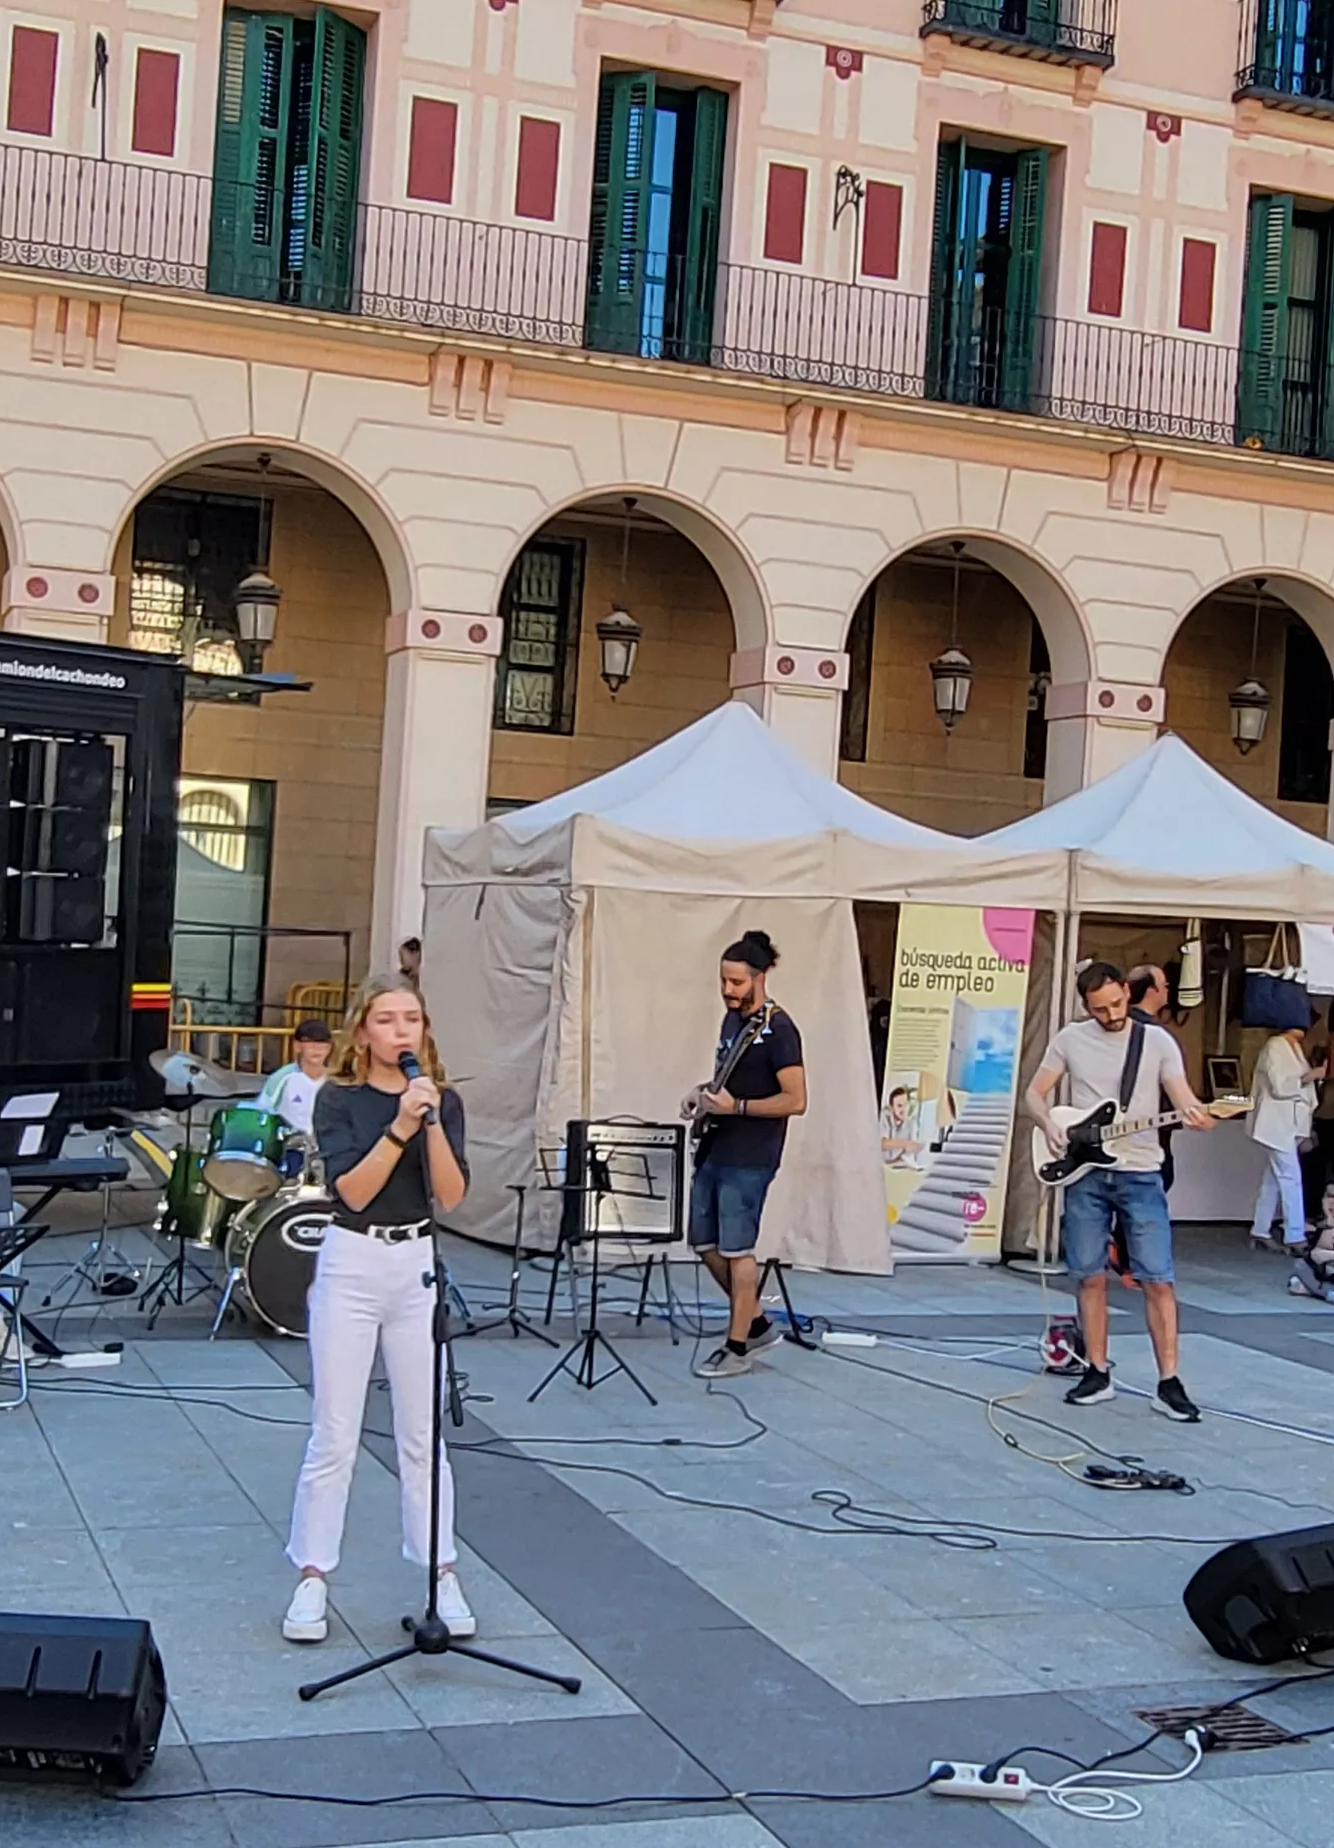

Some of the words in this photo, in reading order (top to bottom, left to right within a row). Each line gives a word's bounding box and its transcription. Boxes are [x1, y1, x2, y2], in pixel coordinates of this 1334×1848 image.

[900, 947, 973, 972] búsqueda
[977, 953, 1026, 973] activa
[898, 969, 920, 988] de
[926, 972, 995, 996] empleo
